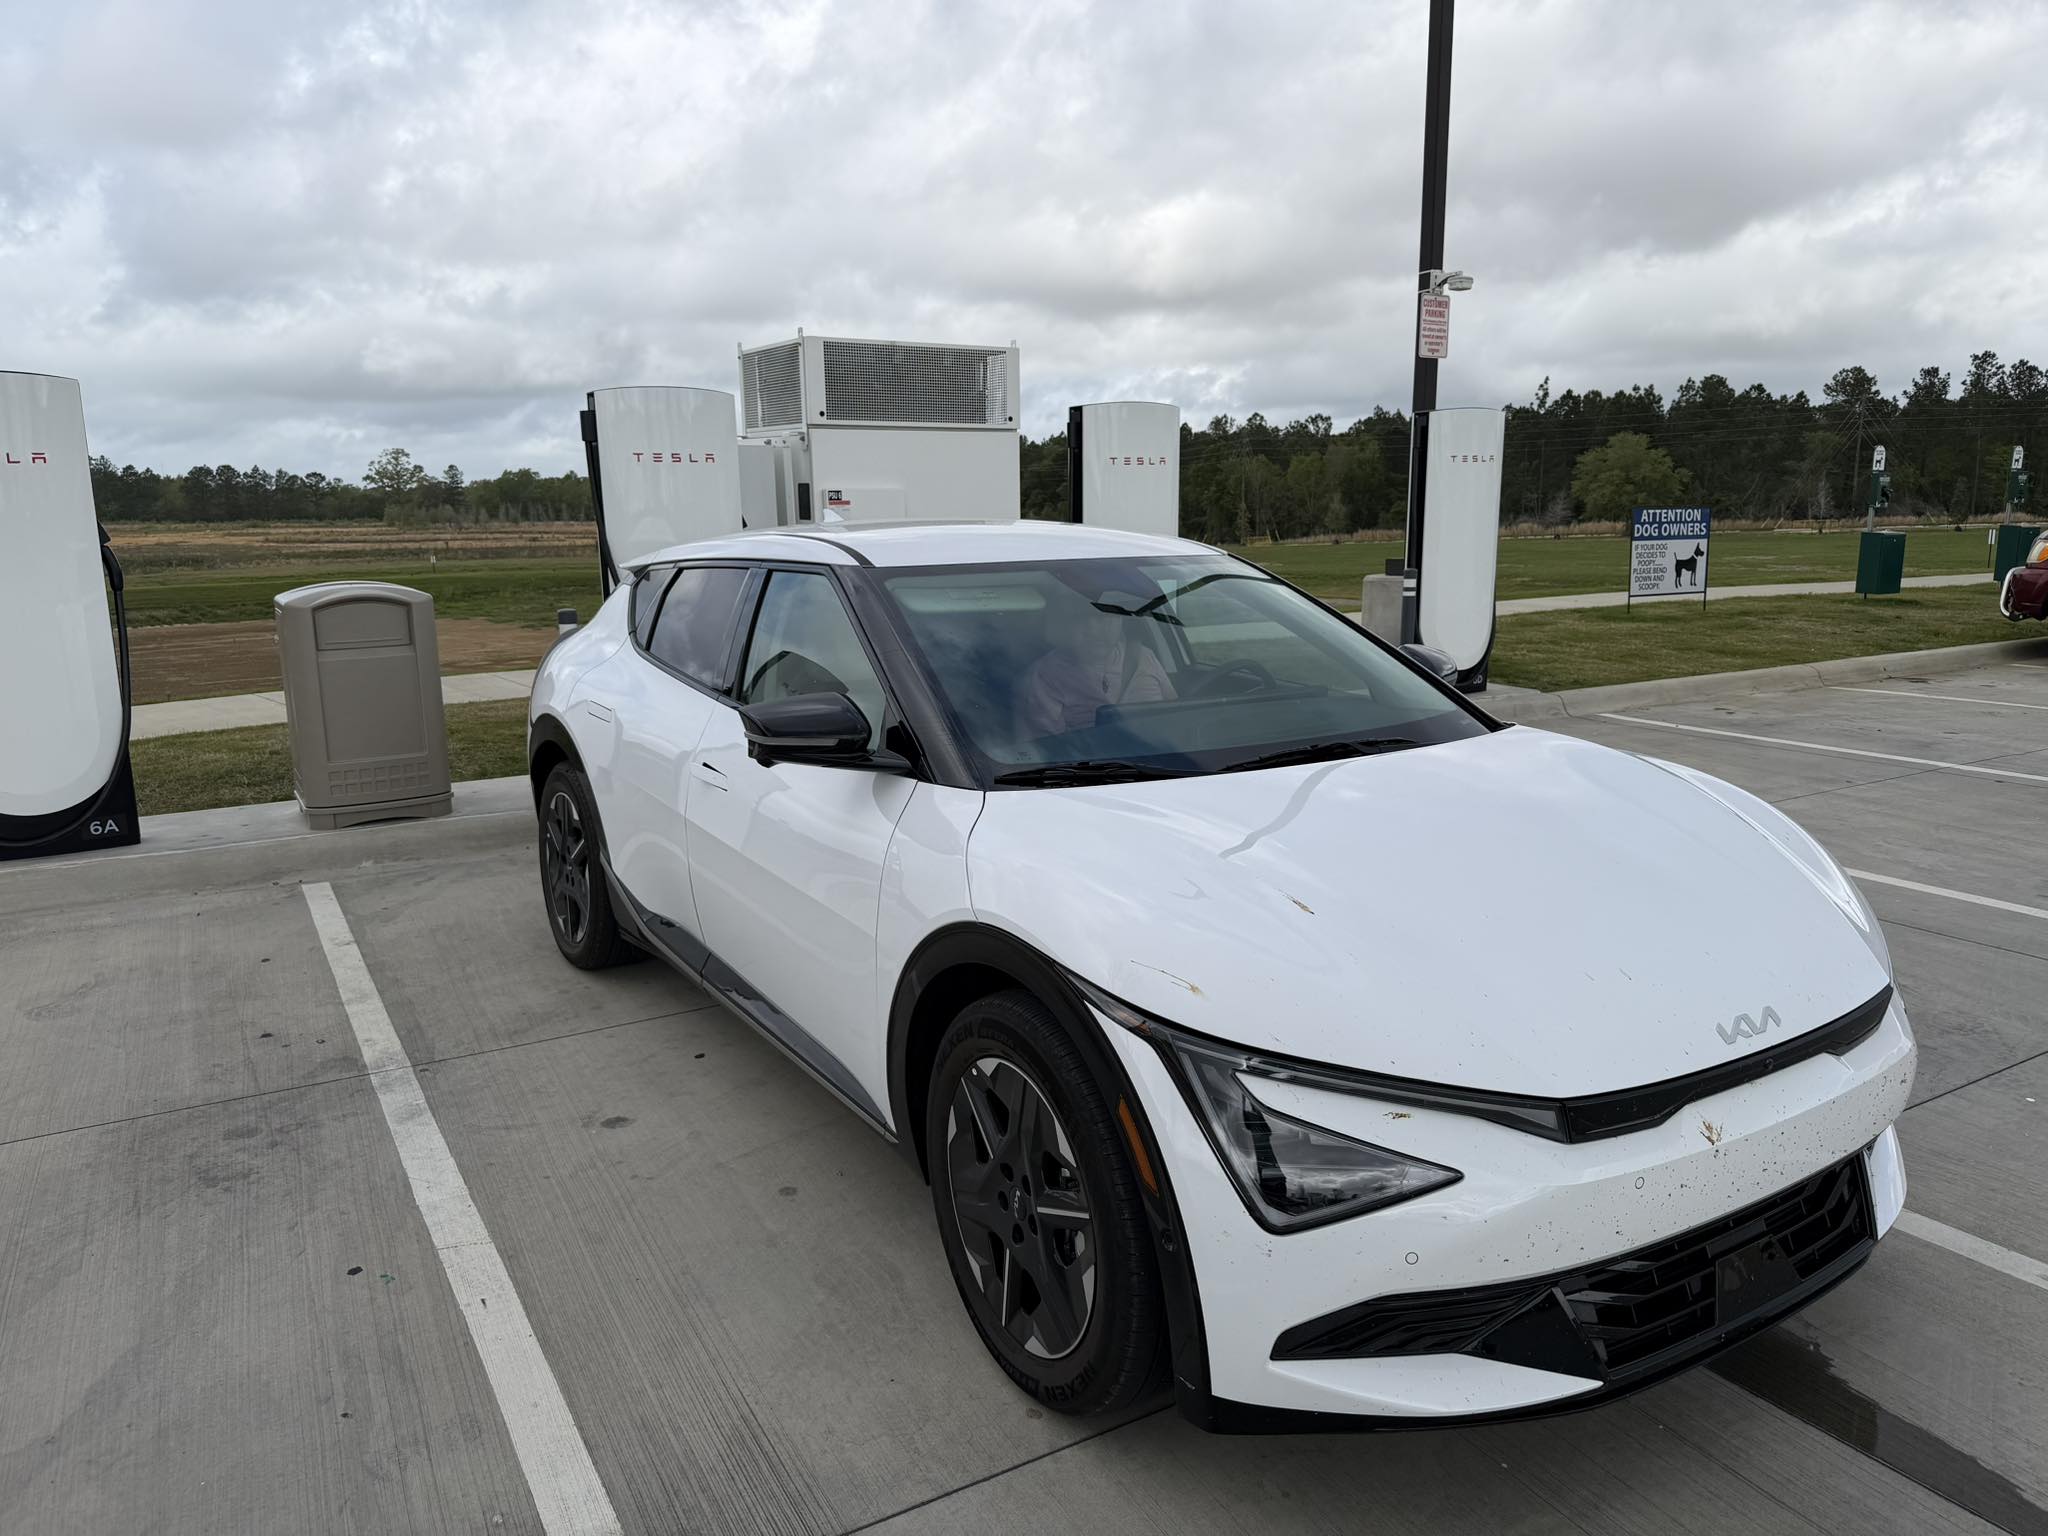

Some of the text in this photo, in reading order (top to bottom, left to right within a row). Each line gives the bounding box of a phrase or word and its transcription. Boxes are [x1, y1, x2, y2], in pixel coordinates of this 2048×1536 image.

[1423, 298, 1448, 309] CUSTOMER
[1425, 308, 1446, 318] PARKING
[632, 452, 715, 463] TESLA
[1109, 456, 1167, 465] TESLA
[1450, 455, 1495, 463] TESLA
[828, 491, 838, 500] PSU
[1641, 508, 1701, 522] ATTENTION
[1634, 522, 1707, 537] DOG OWNERS
[1655, 543, 1668, 551] DOG
[1635, 551, 1658, 559] DECIDES
[1632, 567, 1652, 575] PLEASE
[1634, 574, 1665, 583] DOWN AND
[89, 819, 120, 835] 6A
[1715, 1006, 1782, 1045] KIA
[1044, 1360, 1096, 1402] NEXEN
